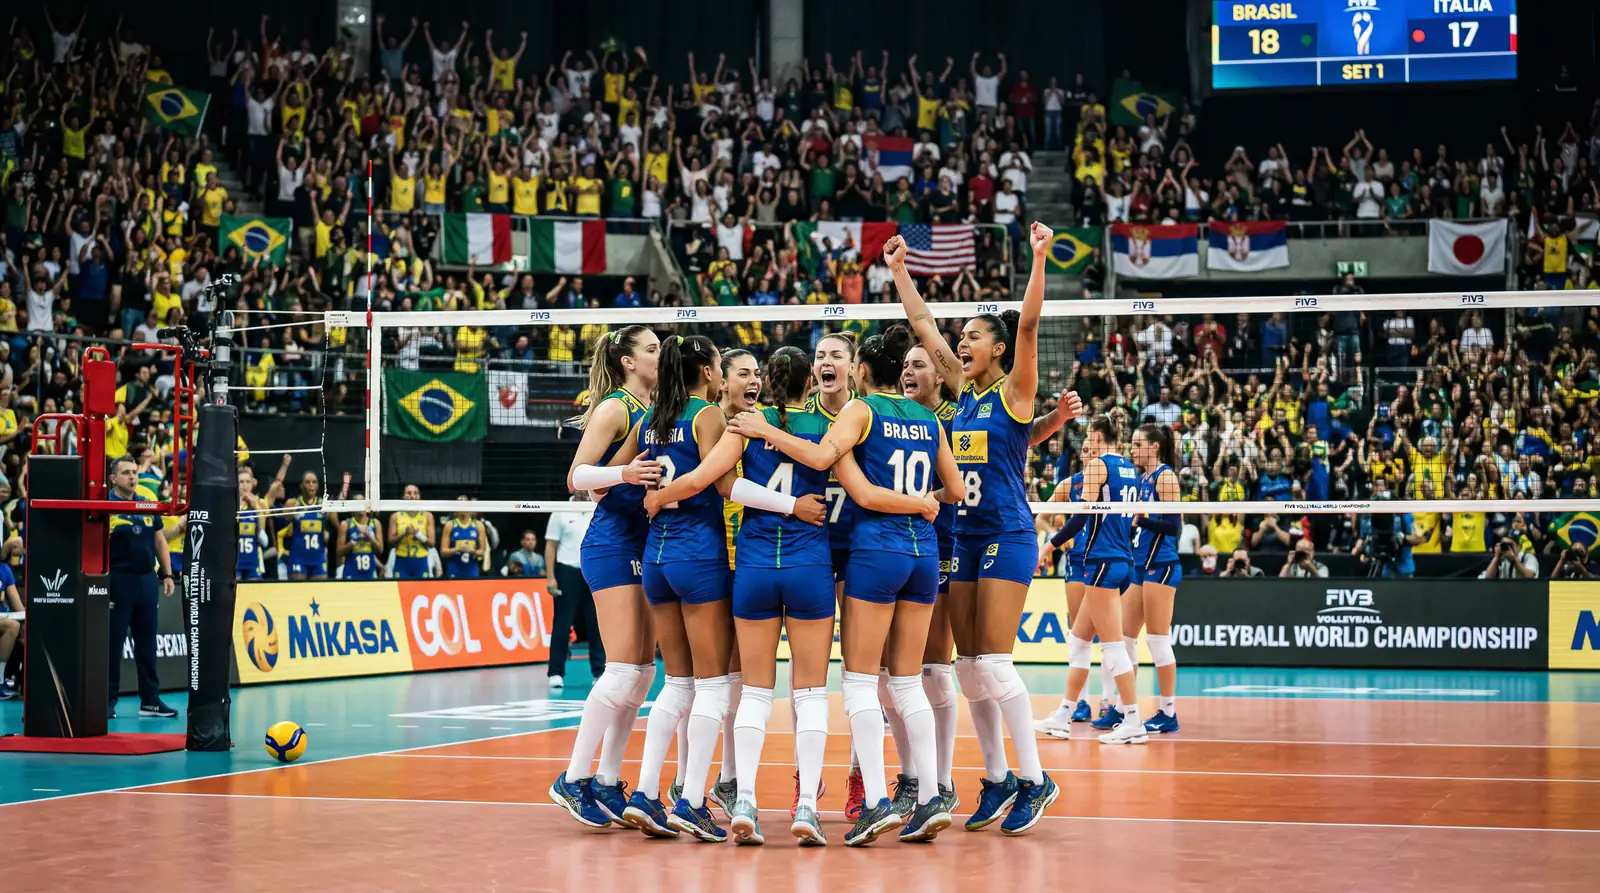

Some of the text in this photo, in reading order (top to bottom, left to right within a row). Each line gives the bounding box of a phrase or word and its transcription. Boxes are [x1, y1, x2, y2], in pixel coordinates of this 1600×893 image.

[1233, 3, 1297, 20] BRASIL
[1433, 0, 1493, 13] ITALIA
[1248, 29, 1280, 54] 18
[1449, 21, 1479, 47] 17
[1342, 63, 1384, 79] SET 1
[1462, 295, 1484, 303] FIVB
[823, 307, 845, 315] FIVB
[977, 304, 998, 312] FIVB
[884, 422, 932, 441] BRASIL
[766, 462, 794, 497] 4
[887, 449, 932, 498] 10
[189, 510, 209, 520] FIVB
[239, 537, 254, 554] 15
[304, 534, 319, 550] 14
[356, 554, 371, 571] 18
[1326, 589, 1374, 606] FIVB
[410, 593, 482, 657] GOL
[491, 591, 551, 650] GOL
[1316, 615, 1383, 625] VOLLEYBALL
[288, 614, 399, 658] MIKASA
[1169, 624, 1538, 650] VOLLEYBALL WORLD CHAMPIONSHIP
[190, 626, 199, 691] CHAMPIONSHIP
